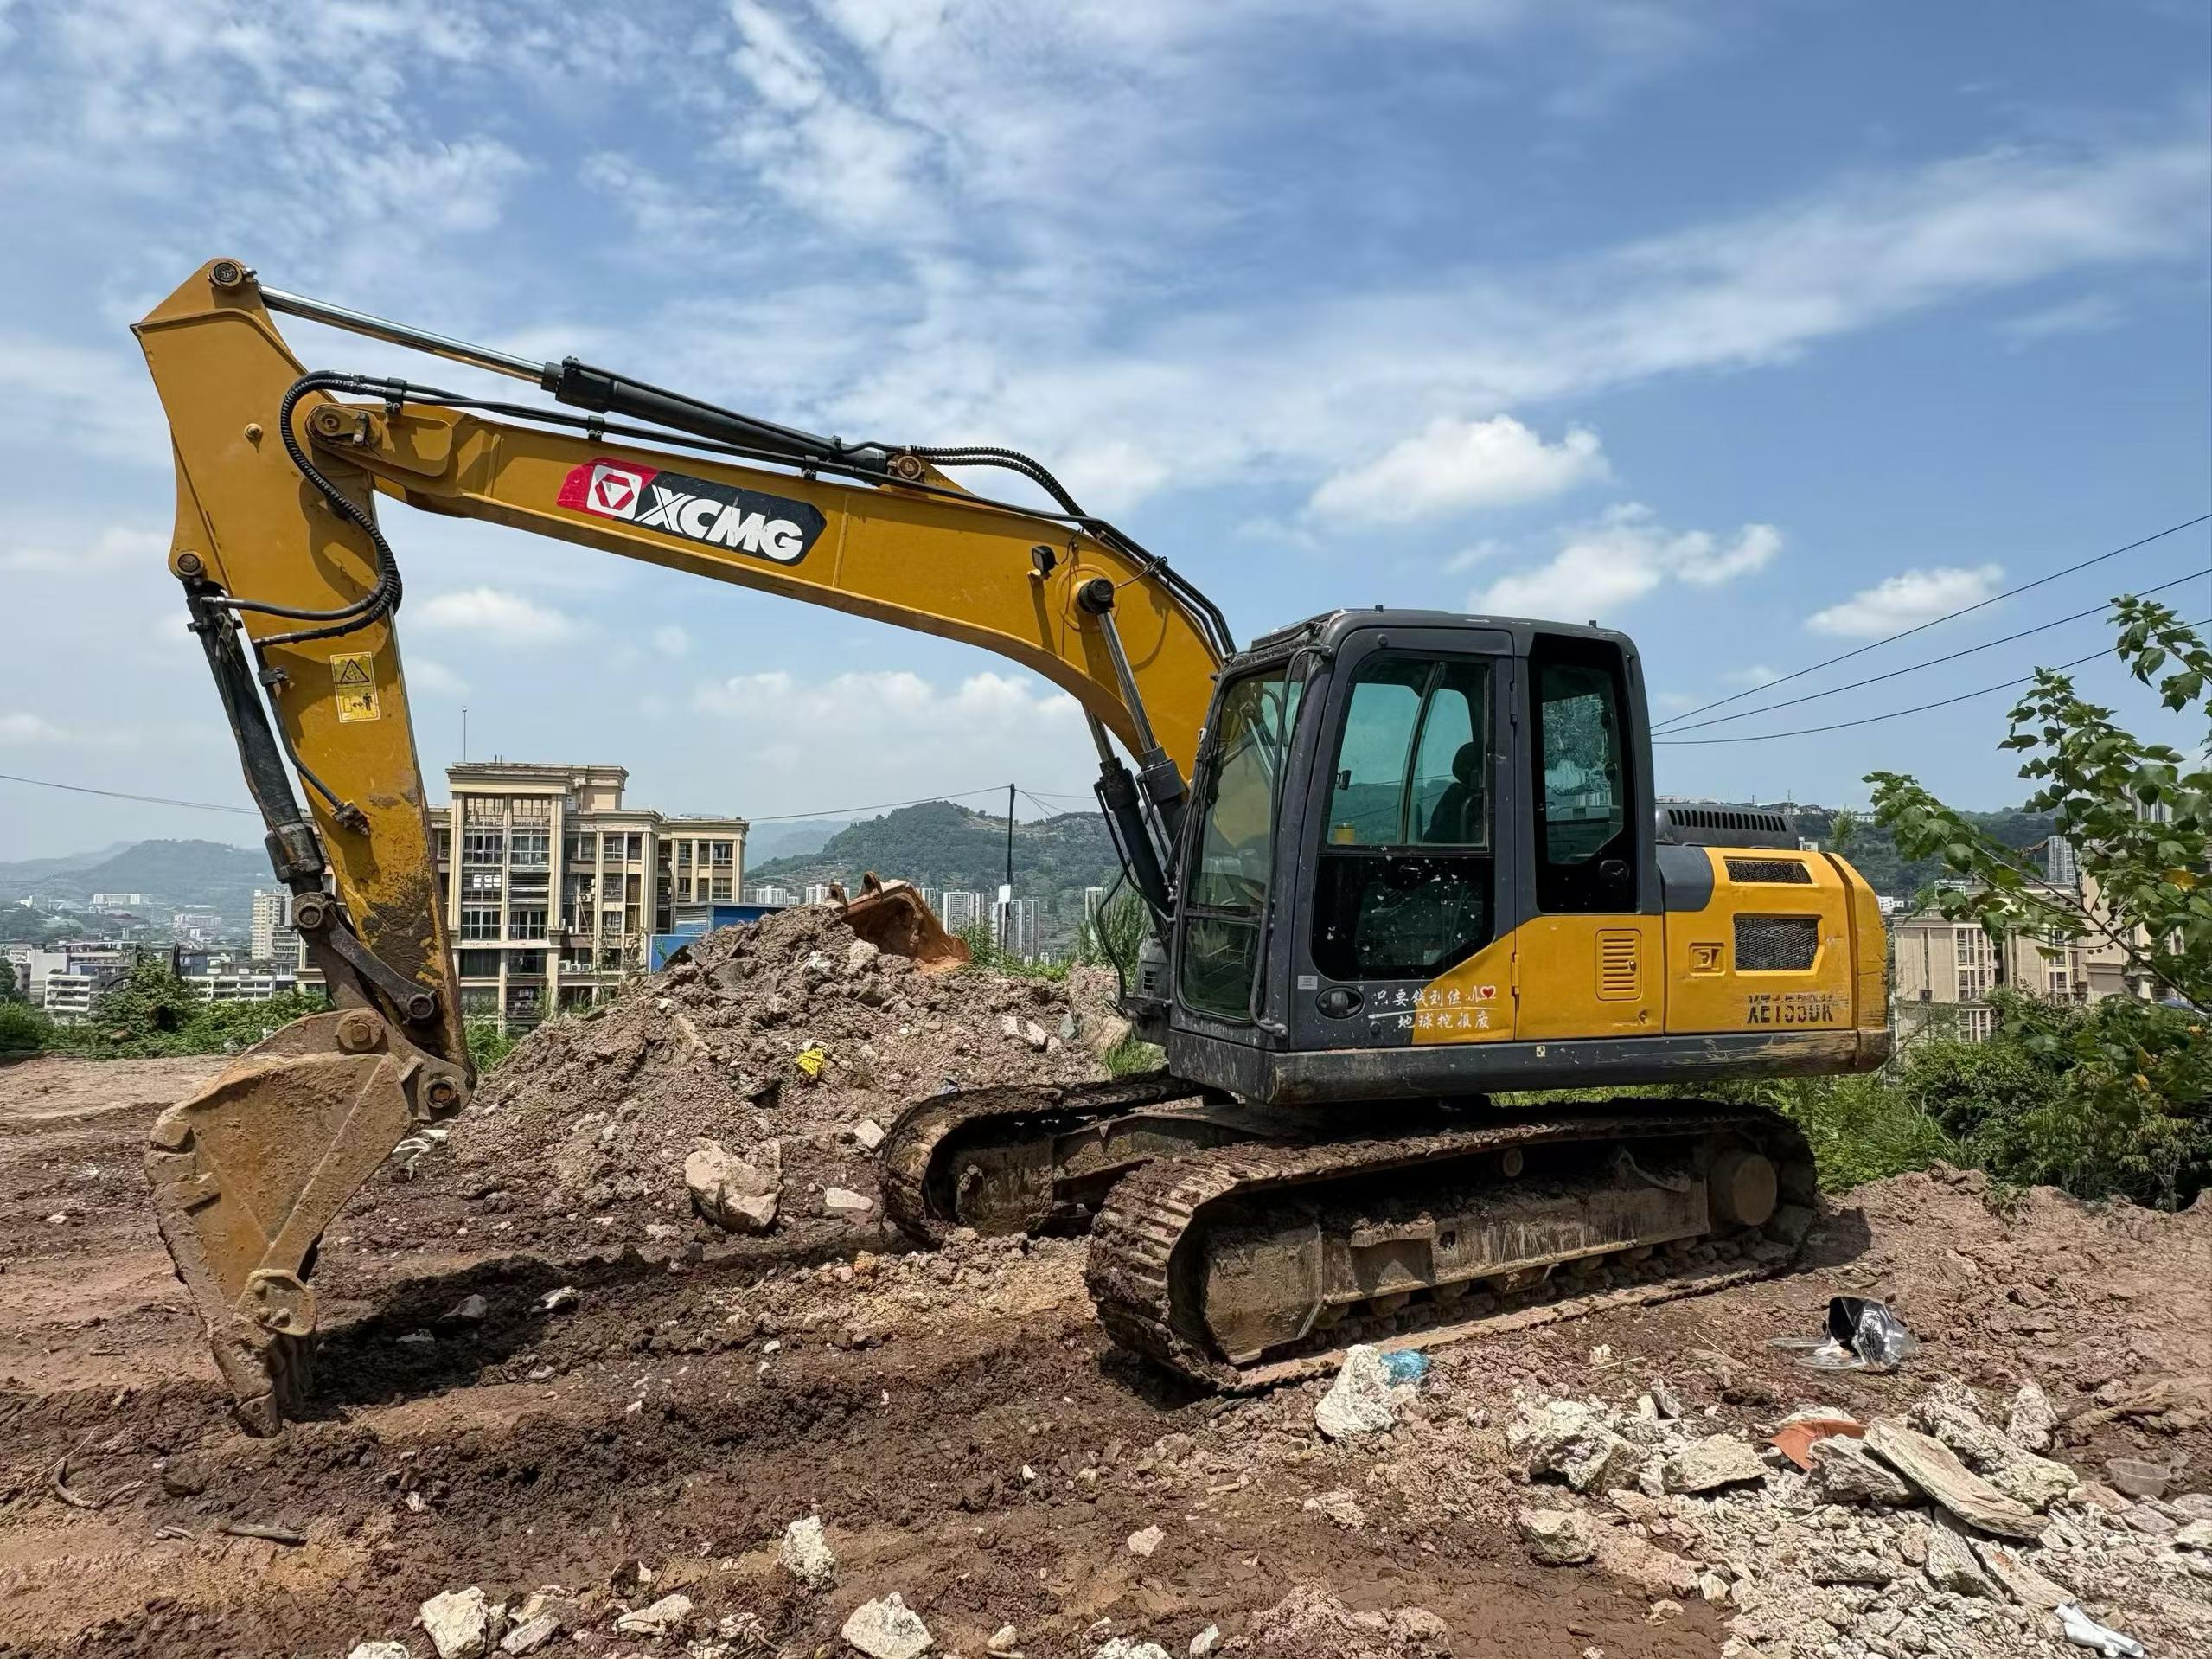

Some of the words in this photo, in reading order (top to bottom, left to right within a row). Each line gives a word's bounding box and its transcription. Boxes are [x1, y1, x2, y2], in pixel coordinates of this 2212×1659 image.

[634, 484, 803, 560] XCMG
[1371, 988, 1461, 1007] 只要钱到位
